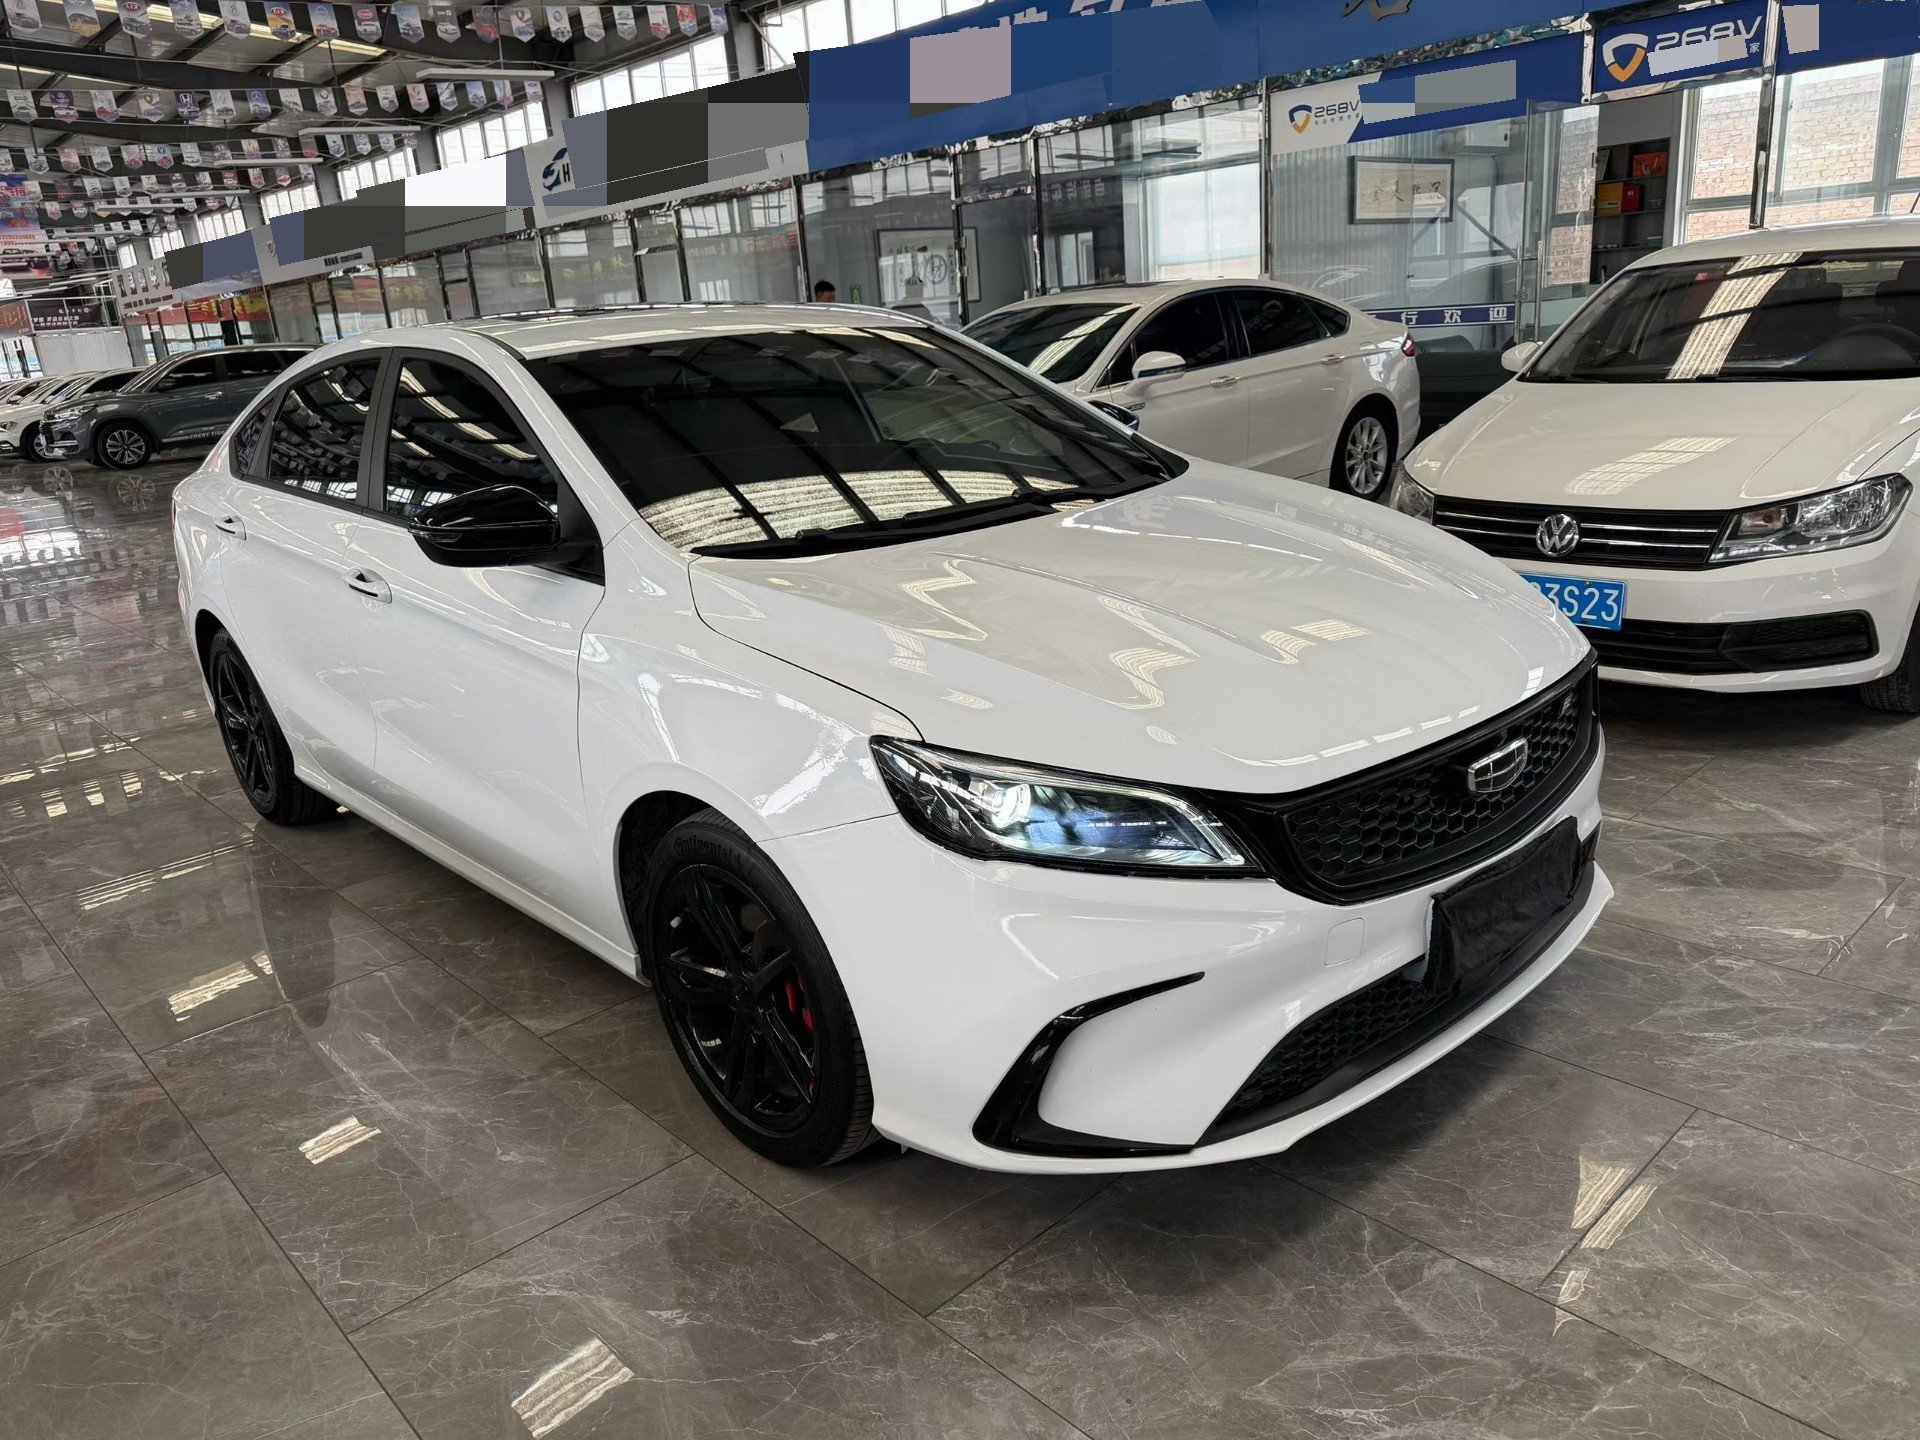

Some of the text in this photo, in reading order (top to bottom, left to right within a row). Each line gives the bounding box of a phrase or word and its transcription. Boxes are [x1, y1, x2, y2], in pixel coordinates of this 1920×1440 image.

[1314, 99, 1360, 118] 268V
[1374, 306, 1507, 325] 行欢迎
[1530, 581, 1620, 622] 3S23
